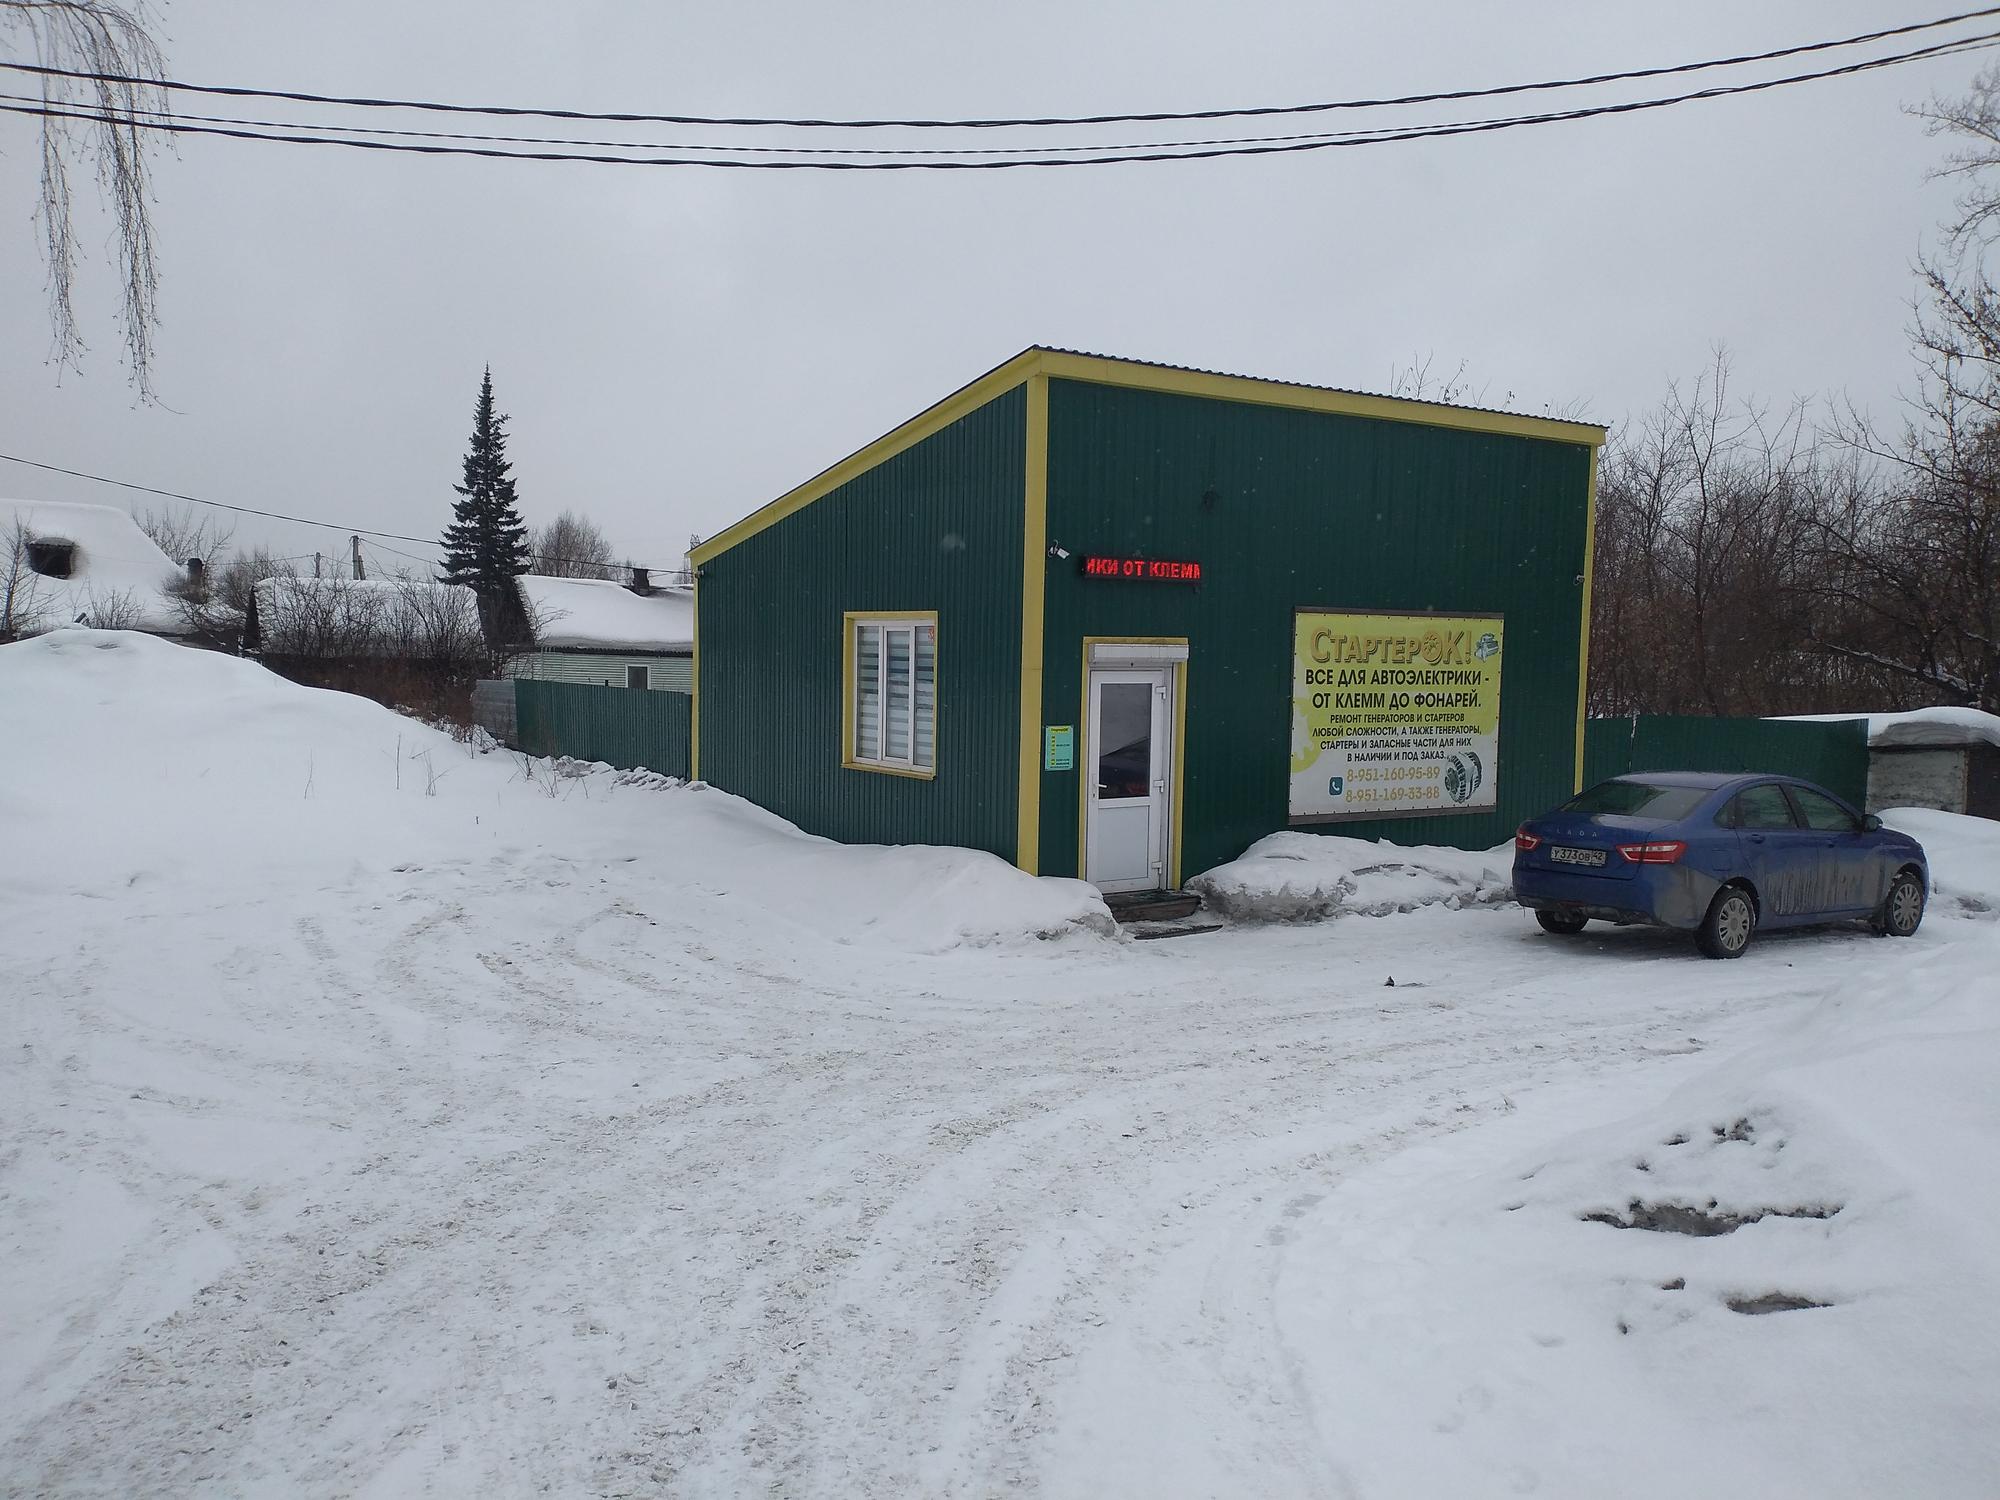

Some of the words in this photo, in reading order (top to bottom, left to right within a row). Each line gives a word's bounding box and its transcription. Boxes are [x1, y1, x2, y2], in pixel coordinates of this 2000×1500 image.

[1123, 561, 1144, 576] ОТ
[1305, 669, 1334, 685] ВСЕ
[1337, 669, 1366, 687] ДЛЯ
[1370, 669, 1482, 686] АВТОЭЛЕКТРИКИ
[1312, 692, 1331, 709] ОТ
[1335, 692, 1385, 709] КЛЕММ
[1388, 692, 1410, 710] ДО
[1414, 688, 1482, 708] ФОНАРЕЙ.
[1330, 714, 1361, 724] РЕМОНТ
[1363, 713, 1414, 723] ГЕНЕРАТОРОВ
[1416, 713, 1422, 722] И
[1424, 713, 1465, 723] СТАРТЕРОВ
[1312, 725, 1344, 737] ЛЮБОЙ
[1345, 726, 1399, 737] СЛОЖНОСТИ,
[1401, 727, 1407, 735] А
[1409, 726, 1434, 735] ТАКЖЕ
[1435, 725, 1482, 735] ГЕНЕРАТОРЫ,
[1320, 740, 1359, 750] СТАРТЕРЫ
[1361, 740, 1367, 749] И
[1369, 739, 1411, 749] ЗАПАСНЫЕ
[1413, 738, 1438, 748] ЧАСТИ
[1438, 738, 1454, 748] ДЛЯ
[1455, 738, 1472, 747] НИХ
[1347, 753, 1353, 762] В
[1354, 752, 1392, 762] НАЛИЧИИ
[1394, 752, 1400, 761] И
[1402, 751, 1419, 761] ПОД
[1347, 766, 1441, 783] 8-951-160-95-89
[1345, 786, 1440, 803] 8-951-169-33-88
[1556, 828, 1596, 837] LADA
